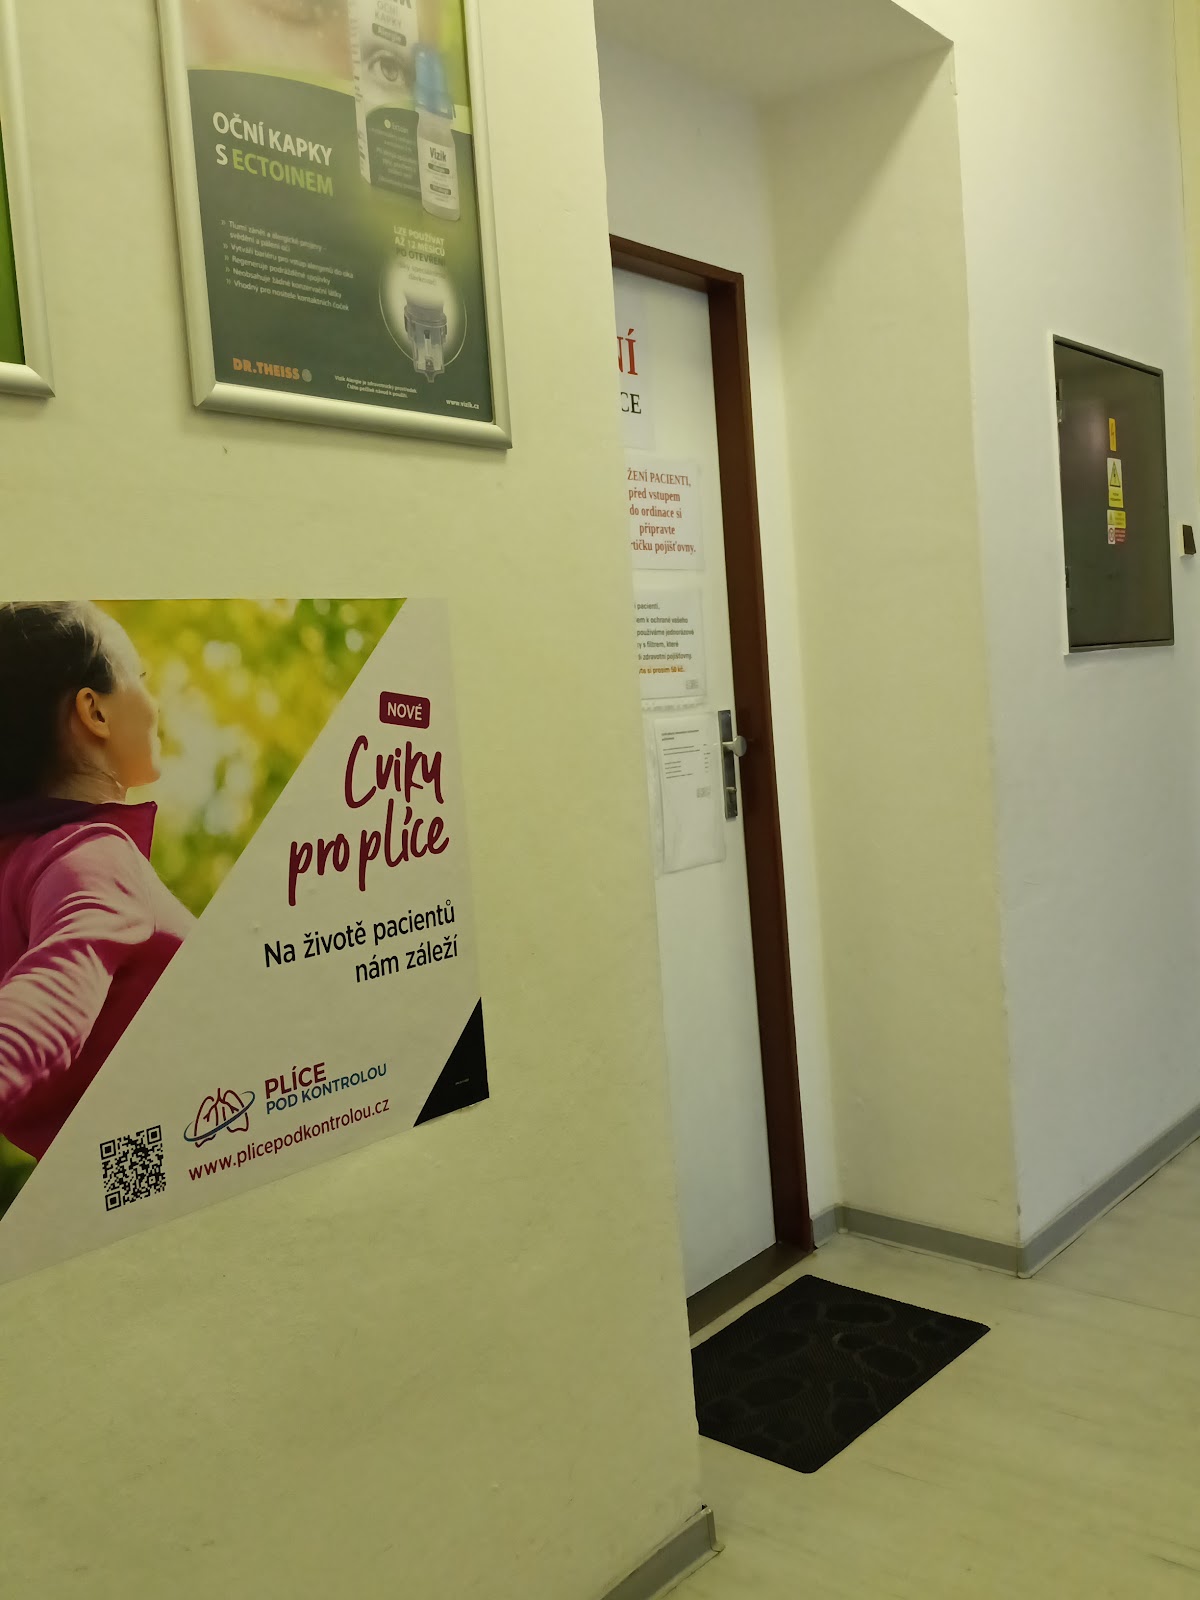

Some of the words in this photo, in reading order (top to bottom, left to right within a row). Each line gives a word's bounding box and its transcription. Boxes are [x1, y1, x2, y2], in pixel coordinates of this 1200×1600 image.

[212, 111, 265, 146] OČNÍ
[269, 130, 332, 166] KAPKY
[429, 147, 447, 162] Vizik
[215, 144, 228, 166] S
[232, 149, 334, 197] ECTOINEM
[393, 224, 407, 237] LZE
[408, 228, 445, 246] POUŽÍVAT
[394, 234, 406, 247] AŽ
[407, 239, 416, 249] 12
[417, 241, 446, 257] MĚSÍCŮ
[230, 243, 254, 256] Vytváří
[277, 255, 289, 264] pro
[395, 246, 407, 258] PO
[231, 255, 268, 271] Regeneruje
[269, 265, 306, 280] podrážděné
[232, 267, 271, 283] Neobsahuje
[234, 279, 259, 293] Vhodný
[259, 286, 271, 296] pro
[445, 398, 480, 410] www.vizik.cz
[627, 467, 648, 482] ŽENÍ
[649, 472, 692, 488] PACIENTI,
[628, 487, 647, 501] před
[648, 490, 681, 504] vstupem
[629, 504, 640, 516] do
[641, 505, 675, 518] ordinace
[676, 507, 683, 519] si
[639, 522, 676, 537] připravte
[386, 702, 423, 721] NOVÉ
[344, 735, 445, 809] Cviky
[288, 833, 350, 907] pro
[358, 798, 450, 892] plíce
[263, 940, 296, 968] Na
[303, 920, 367, 959] životě
[373, 899, 456, 946] pacientů
[355, 954, 400, 984] nám
[405, 934, 459, 970] záleží
[264, 1062, 328, 1099] PLÍCE
[265, 1093, 299, 1115] POD
[301, 1063, 388, 1104] KONTROLOU
[188, 1098, 391, 1181] www.plicepodkontrolou.cz
